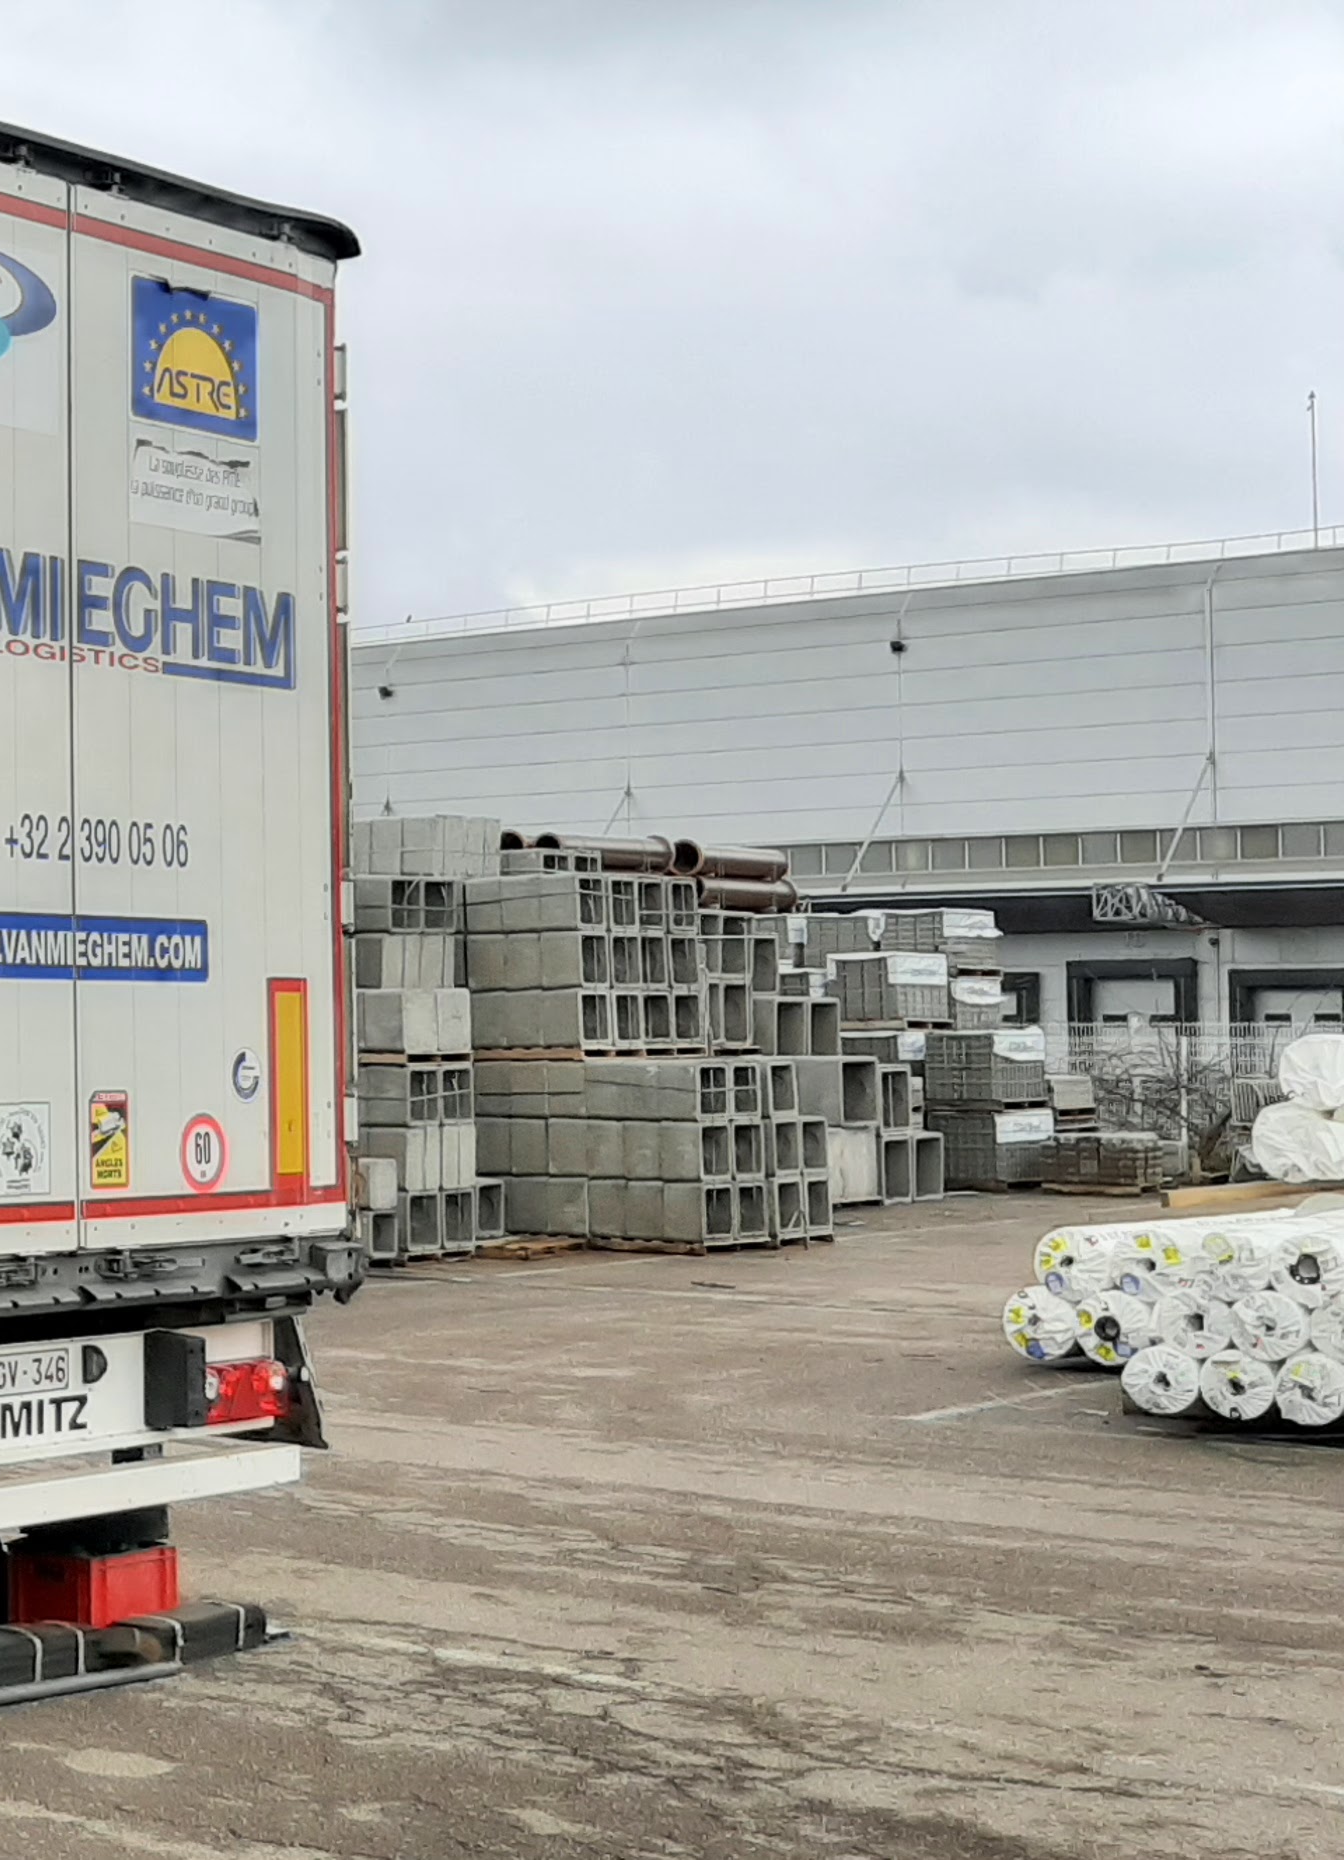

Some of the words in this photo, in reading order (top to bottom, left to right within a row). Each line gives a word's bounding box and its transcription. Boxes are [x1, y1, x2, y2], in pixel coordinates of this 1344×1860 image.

[156, 367, 232, 412] ASTRE
[4, 813, 49, 860] +32
[57, 816, 71, 861] 2
[80, 817, 121, 864] 390
[128, 821, 155, 867] 05
[162, 824, 188, 868] 06
[95, 1158, 123, 1168] ANGLES
[194, 1131, 211, 1165] 60
[96, 1169, 122, 1179] MORTS
